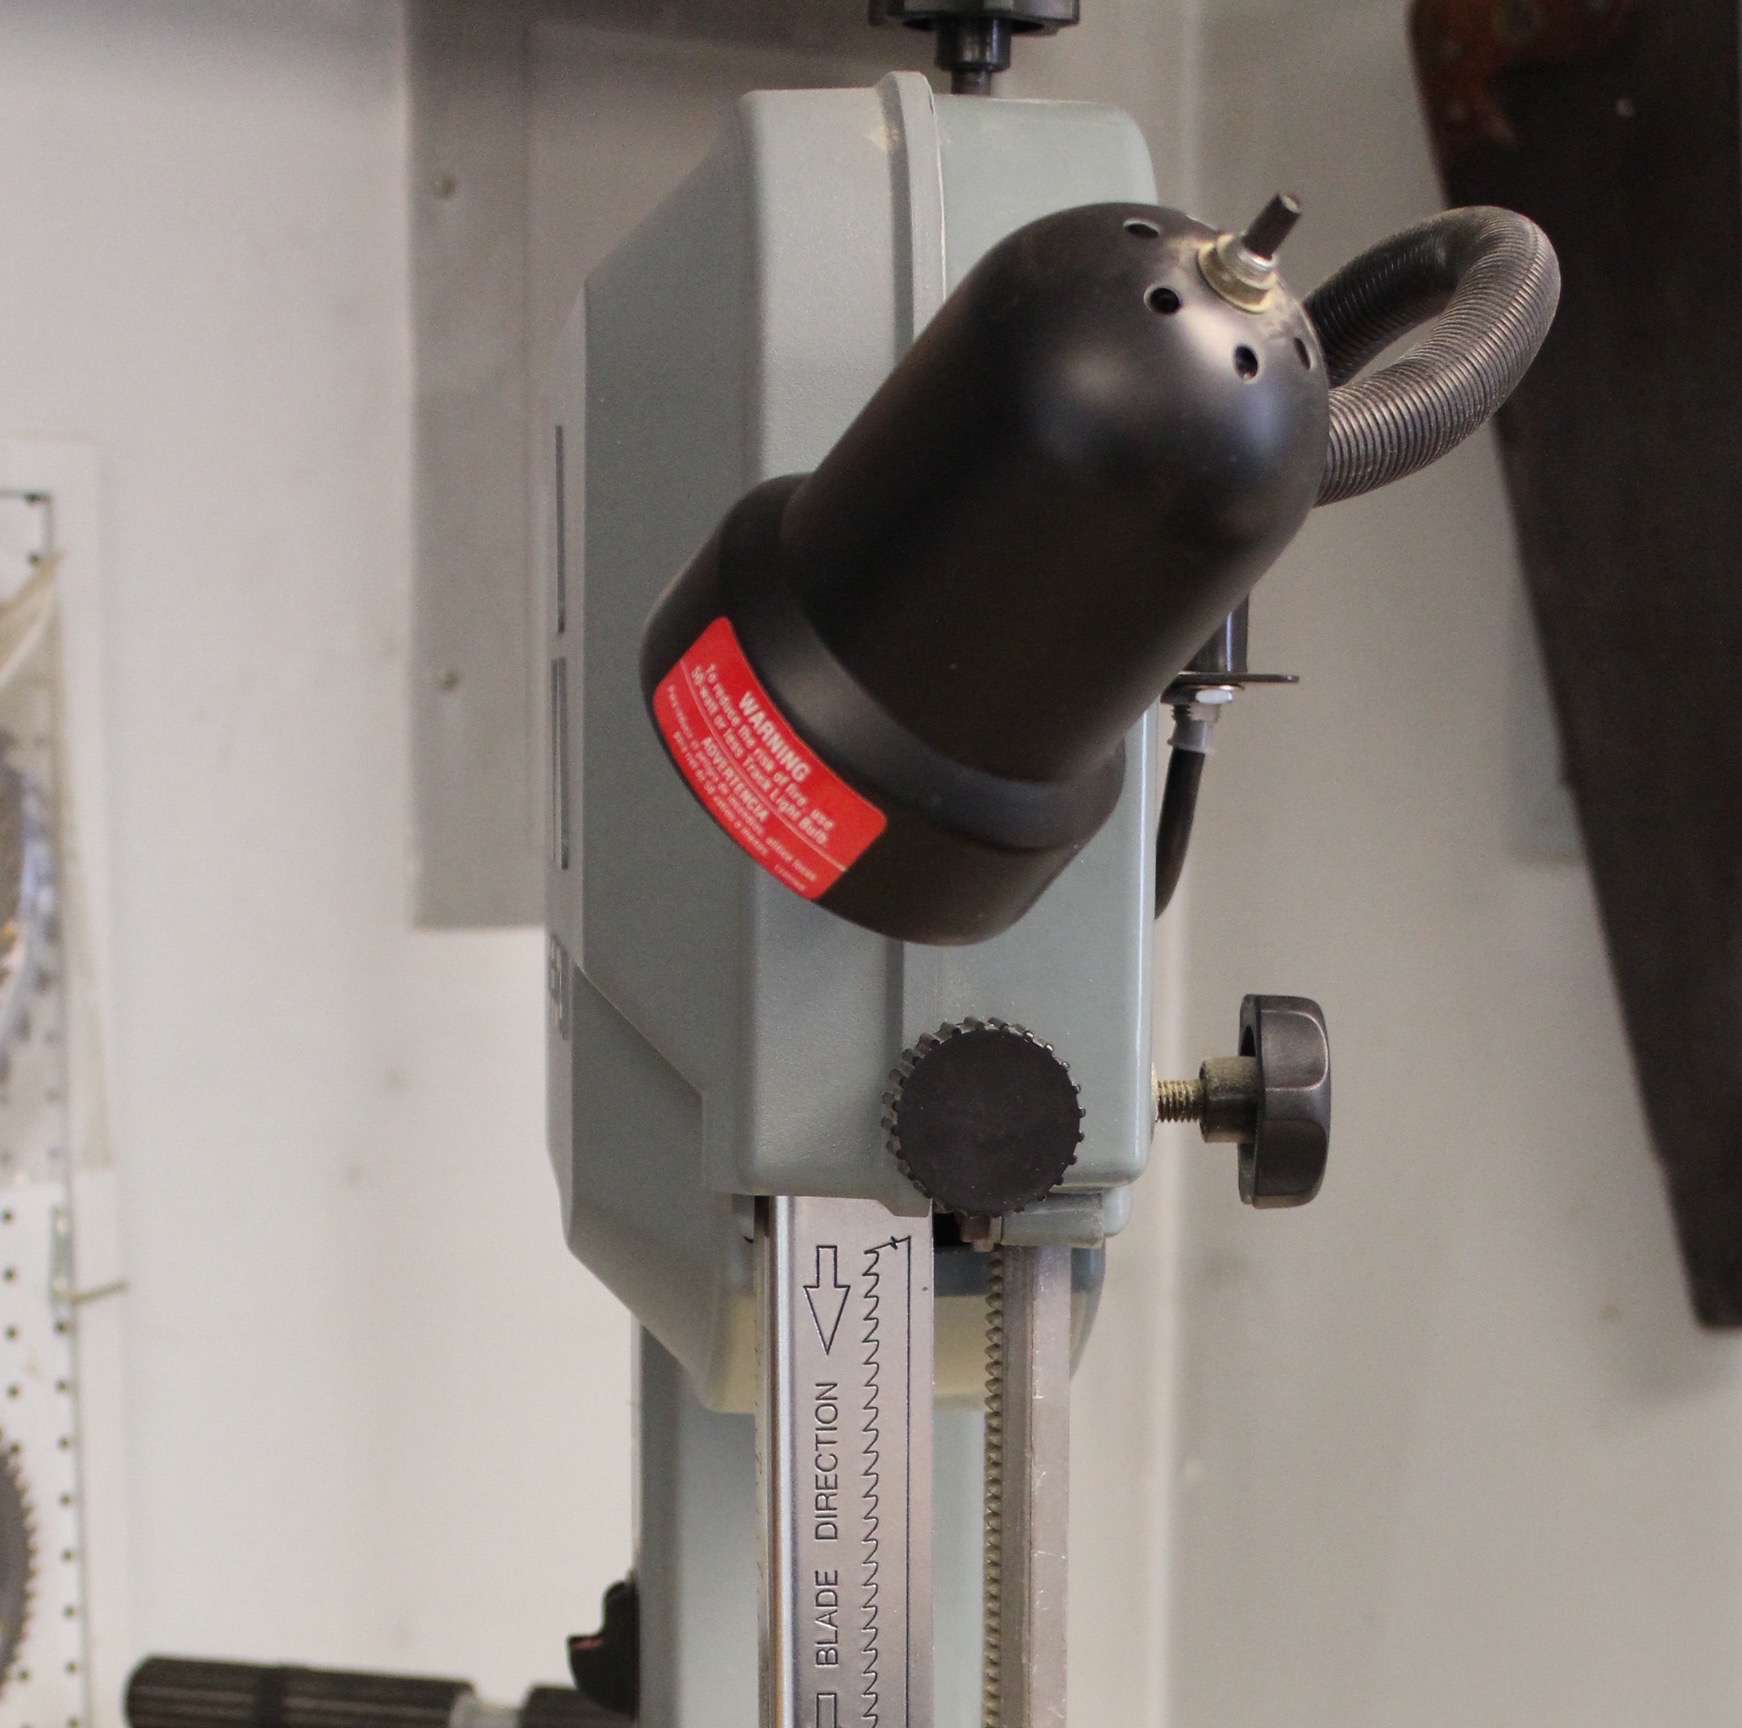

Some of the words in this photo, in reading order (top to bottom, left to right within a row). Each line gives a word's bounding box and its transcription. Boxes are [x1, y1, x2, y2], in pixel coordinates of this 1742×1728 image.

[702, 737, 768, 821] ADVERTENCIA
[704, 663, 717, 683] To
[713, 683, 741, 726] reduce
[738, 724, 756, 748] the
[752, 747, 775, 773] risk
[773, 771, 790, 786] of
[810, 808, 835, 831] use
[714, 715, 726, 729] or
[723, 728, 744, 758] less
[743, 754, 772, 792] Track
[769, 788, 801, 820] Light
[740, 692, 810, 781] WARNING
[815, 1381, 838, 1541] DIRECTION
[815, 1569, 838, 1667] BLADE
